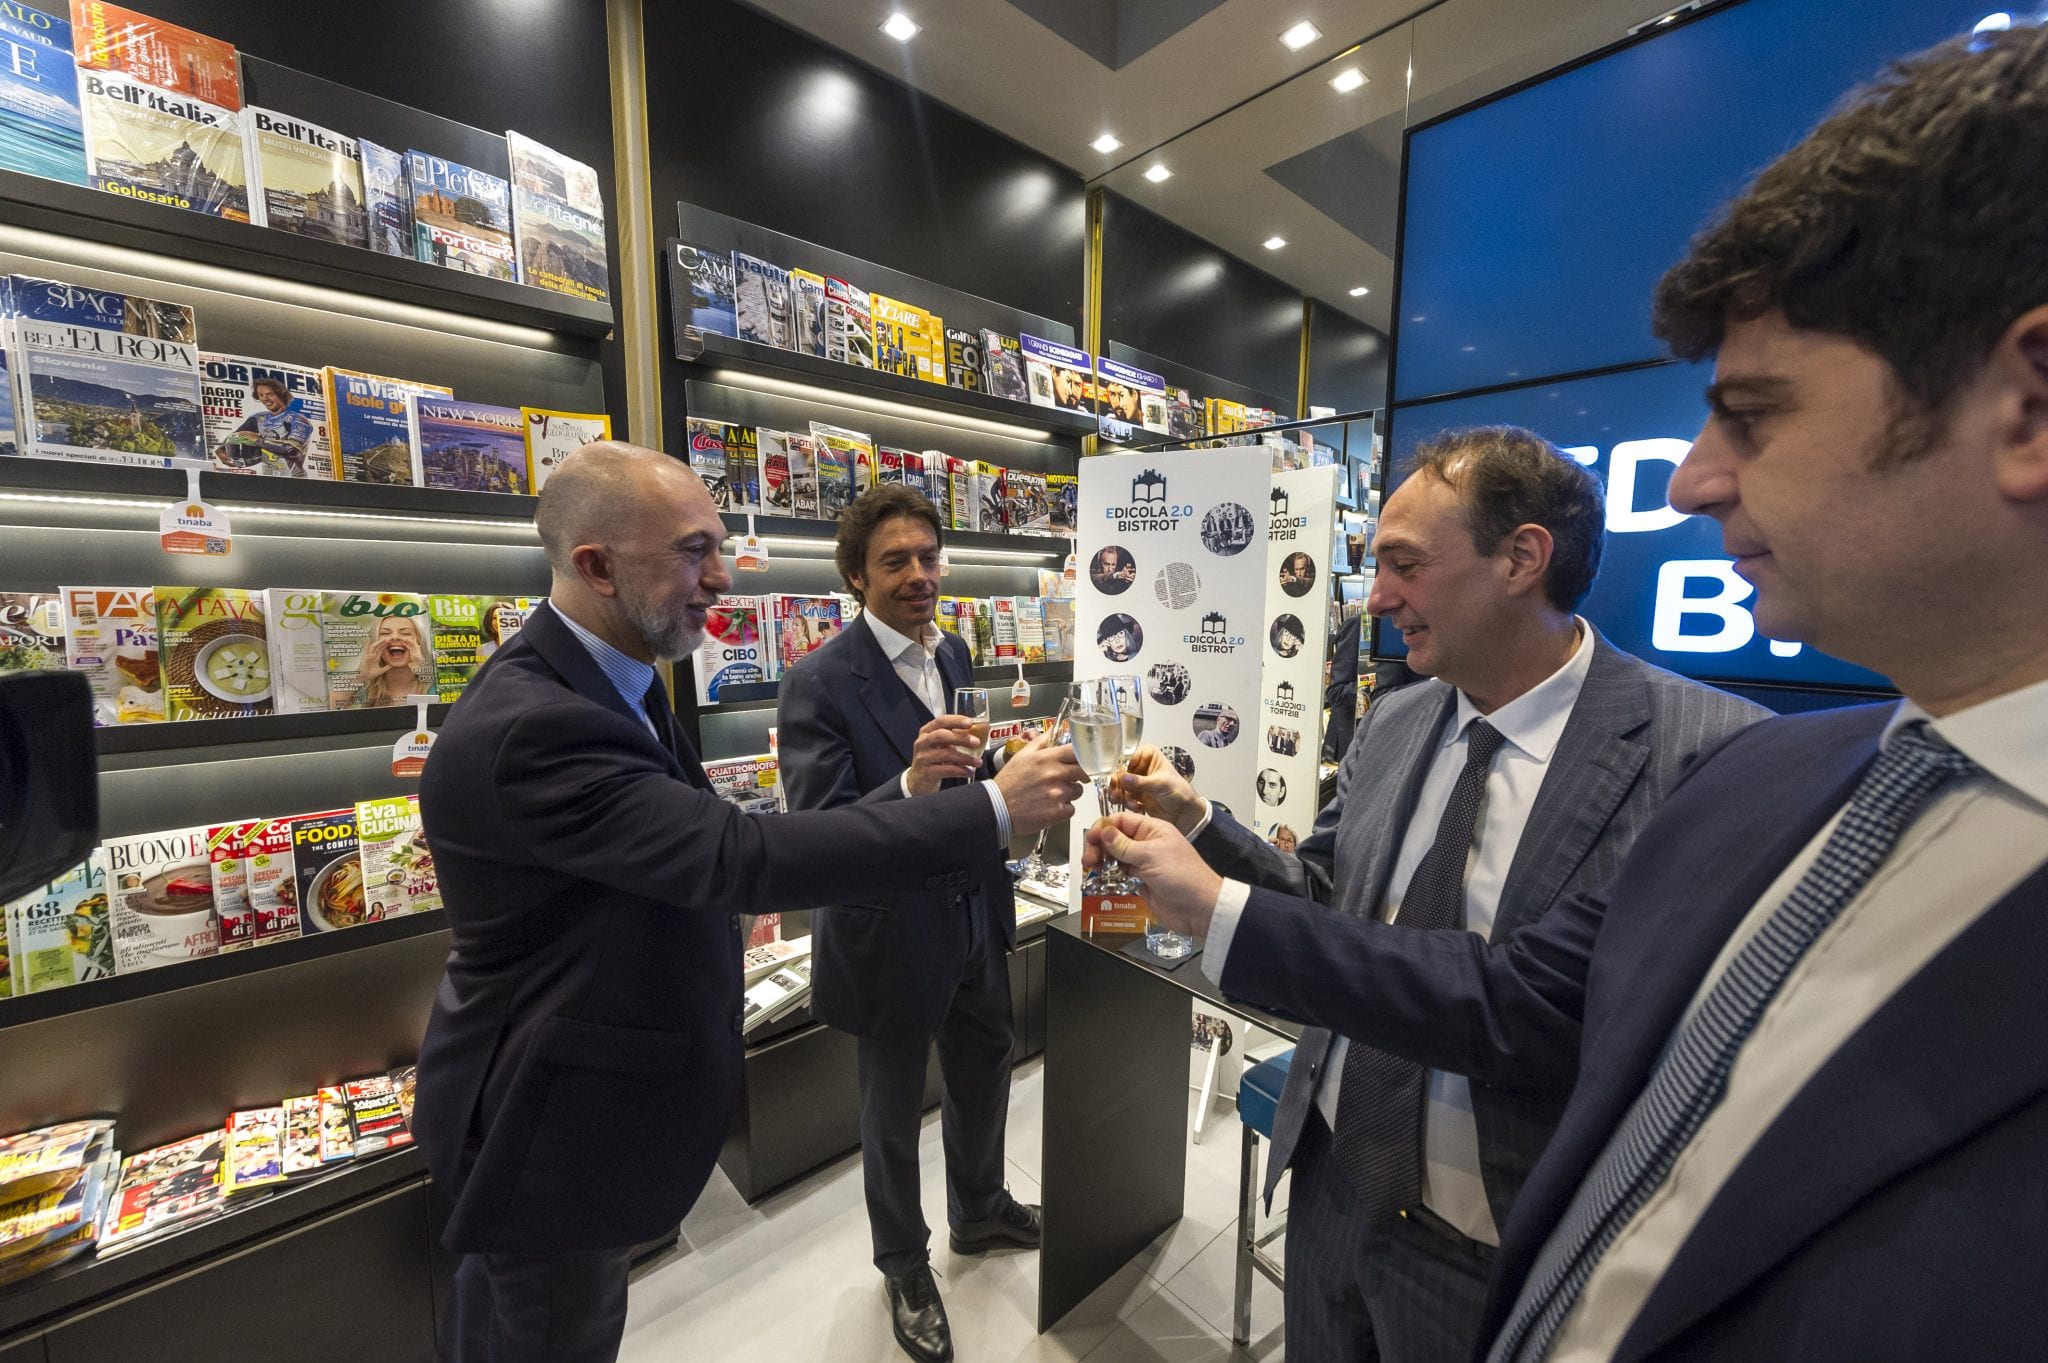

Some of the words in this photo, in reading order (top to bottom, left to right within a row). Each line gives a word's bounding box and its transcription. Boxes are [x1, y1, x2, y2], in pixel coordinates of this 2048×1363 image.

[106, 181, 191, 209] Golosario
[24, 327, 193, 367] BELL'EUROPA
[32, 355, 107, 372] Slovenia
[347, 392, 385, 409] Isole
[423, 404, 466, 421] NEW
[467, 409, 520, 429] YORK
[318, 426, 327, 437] 8
[1106, 504, 1168, 519] EDICOLA
[1170, 504, 1194, 518] 2.0
[1118, 518, 1180, 533] BISTROT
[163, 598, 184, 618] A
[340, 594, 428, 618] bio
[434, 598, 476, 618] Bio
[435, 634, 468, 644] DIETA
[469, 634, 480, 643] DI
[1183, 634, 1227, 645] EDICOLA
[1228, 636, 1245, 646] 2.0
[722, 648, 757, 661] CIBO
[1191, 643, 1236, 655] BISTROT
[437, 656, 469, 664] SUGAR
[408, 744, 430, 753] tinab
[711, 775, 738, 785] VOLVO
[731, 780, 753, 789] XC40
[360, 801, 398, 821] Eva
[360, 814, 421, 837] CUCINA
[295, 824, 352, 845] FOOD
[109, 836, 186, 870] BUONO
[27, 901, 61, 920] 68
[1114, 901, 1137, 910] tinaba
[266, 919, 278, 931] di
